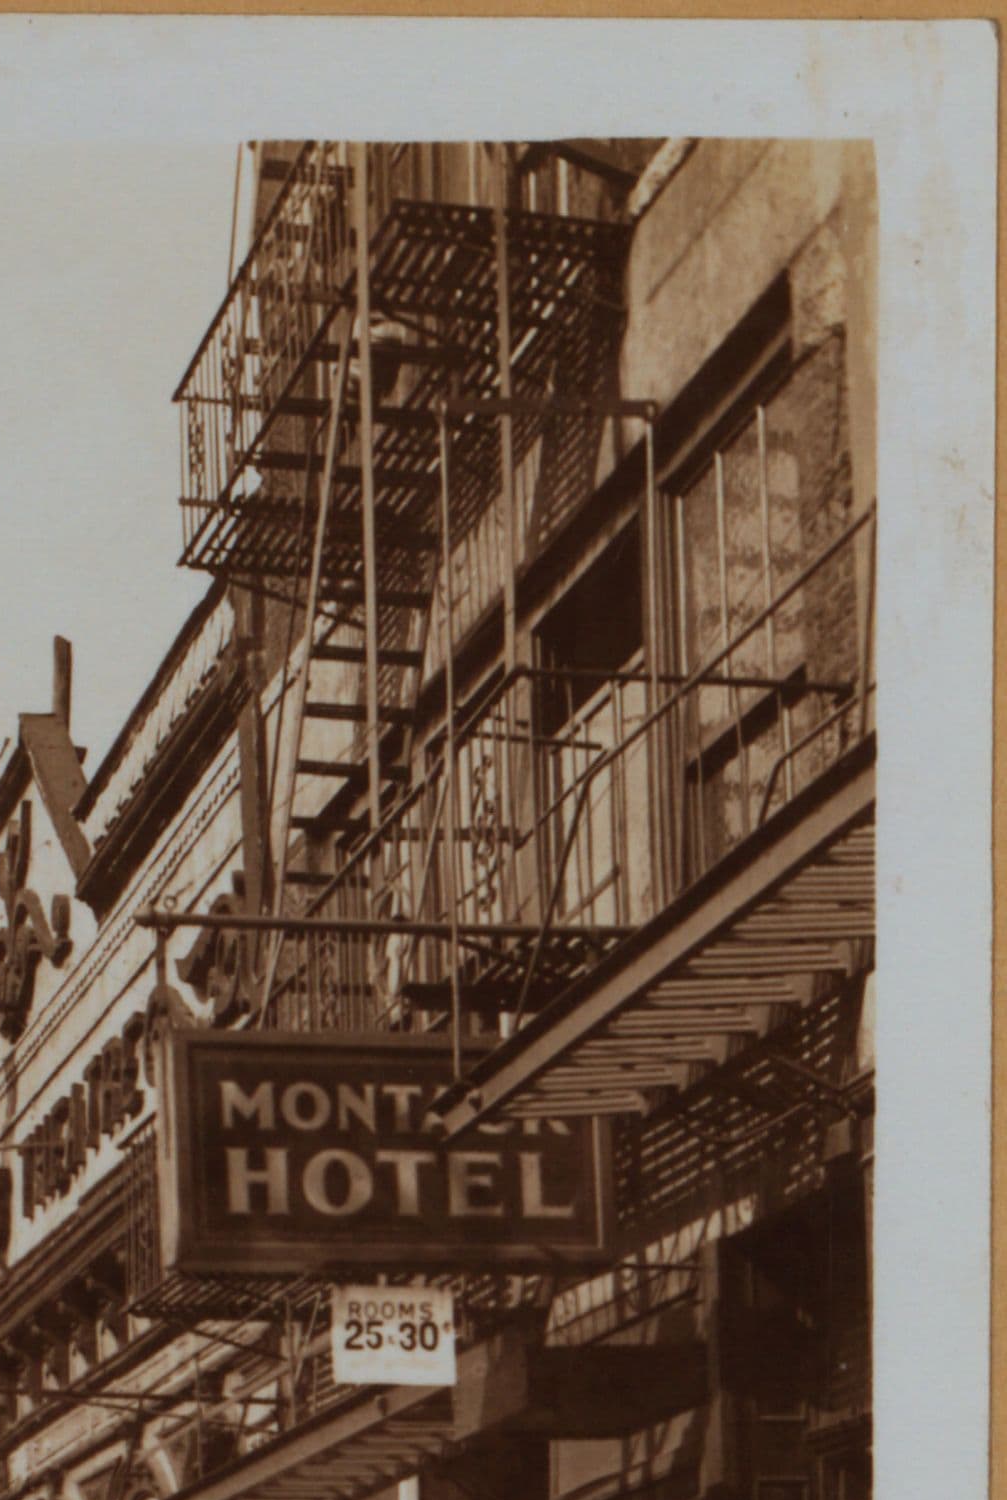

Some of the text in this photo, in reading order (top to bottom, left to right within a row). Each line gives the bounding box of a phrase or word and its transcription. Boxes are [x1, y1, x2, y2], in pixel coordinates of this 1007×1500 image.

[220, 1080, 572, 1135] MONT
[225, 1147, 574, 1218] HOTEL
[348, 1301, 433, 1321] ROOMS
